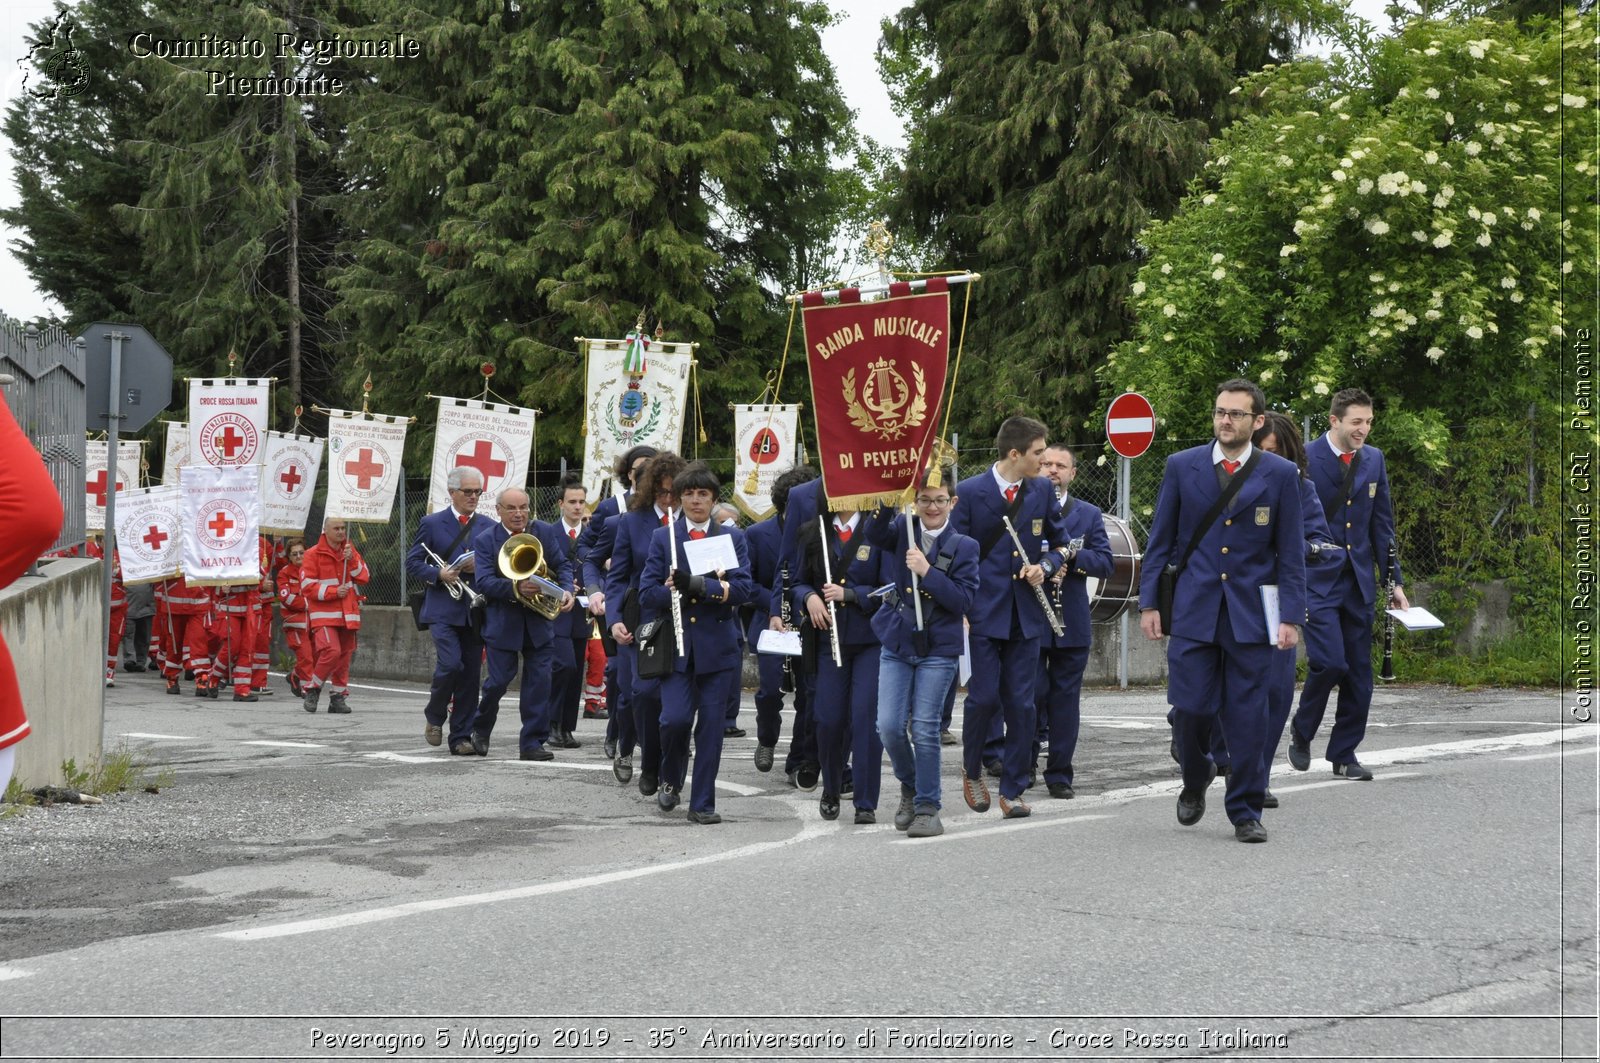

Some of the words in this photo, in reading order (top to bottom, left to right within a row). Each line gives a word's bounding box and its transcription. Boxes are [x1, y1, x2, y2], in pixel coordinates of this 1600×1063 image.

[815, 322, 864, 360] BANDA
[874, 317, 942, 348] MUSICALE
[200, 397, 218, 406] CROCE
[218, 397, 235, 406] ROSSA
[235, 397, 258, 406] ITALIANA
[202, 415, 233, 448] CONVENZIONE
[234, 416, 242, 424] DI
[240, 421, 255, 448] GINEVRA
[439, 417, 467, 428] CROCE
[468, 422, 495, 433] ROSSA
[496, 426, 531, 437] ITALIANA
[330, 429, 353, 438] CROCE
[353, 431, 376, 440] ROSSA
[376, 433, 404, 441] ITALIANA
[839, 452, 854, 469] DI
[881, 470, 893, 479] dal
[343, 506, 378, 515] MORETTA
[201, 556, 242, 568] MANTA
